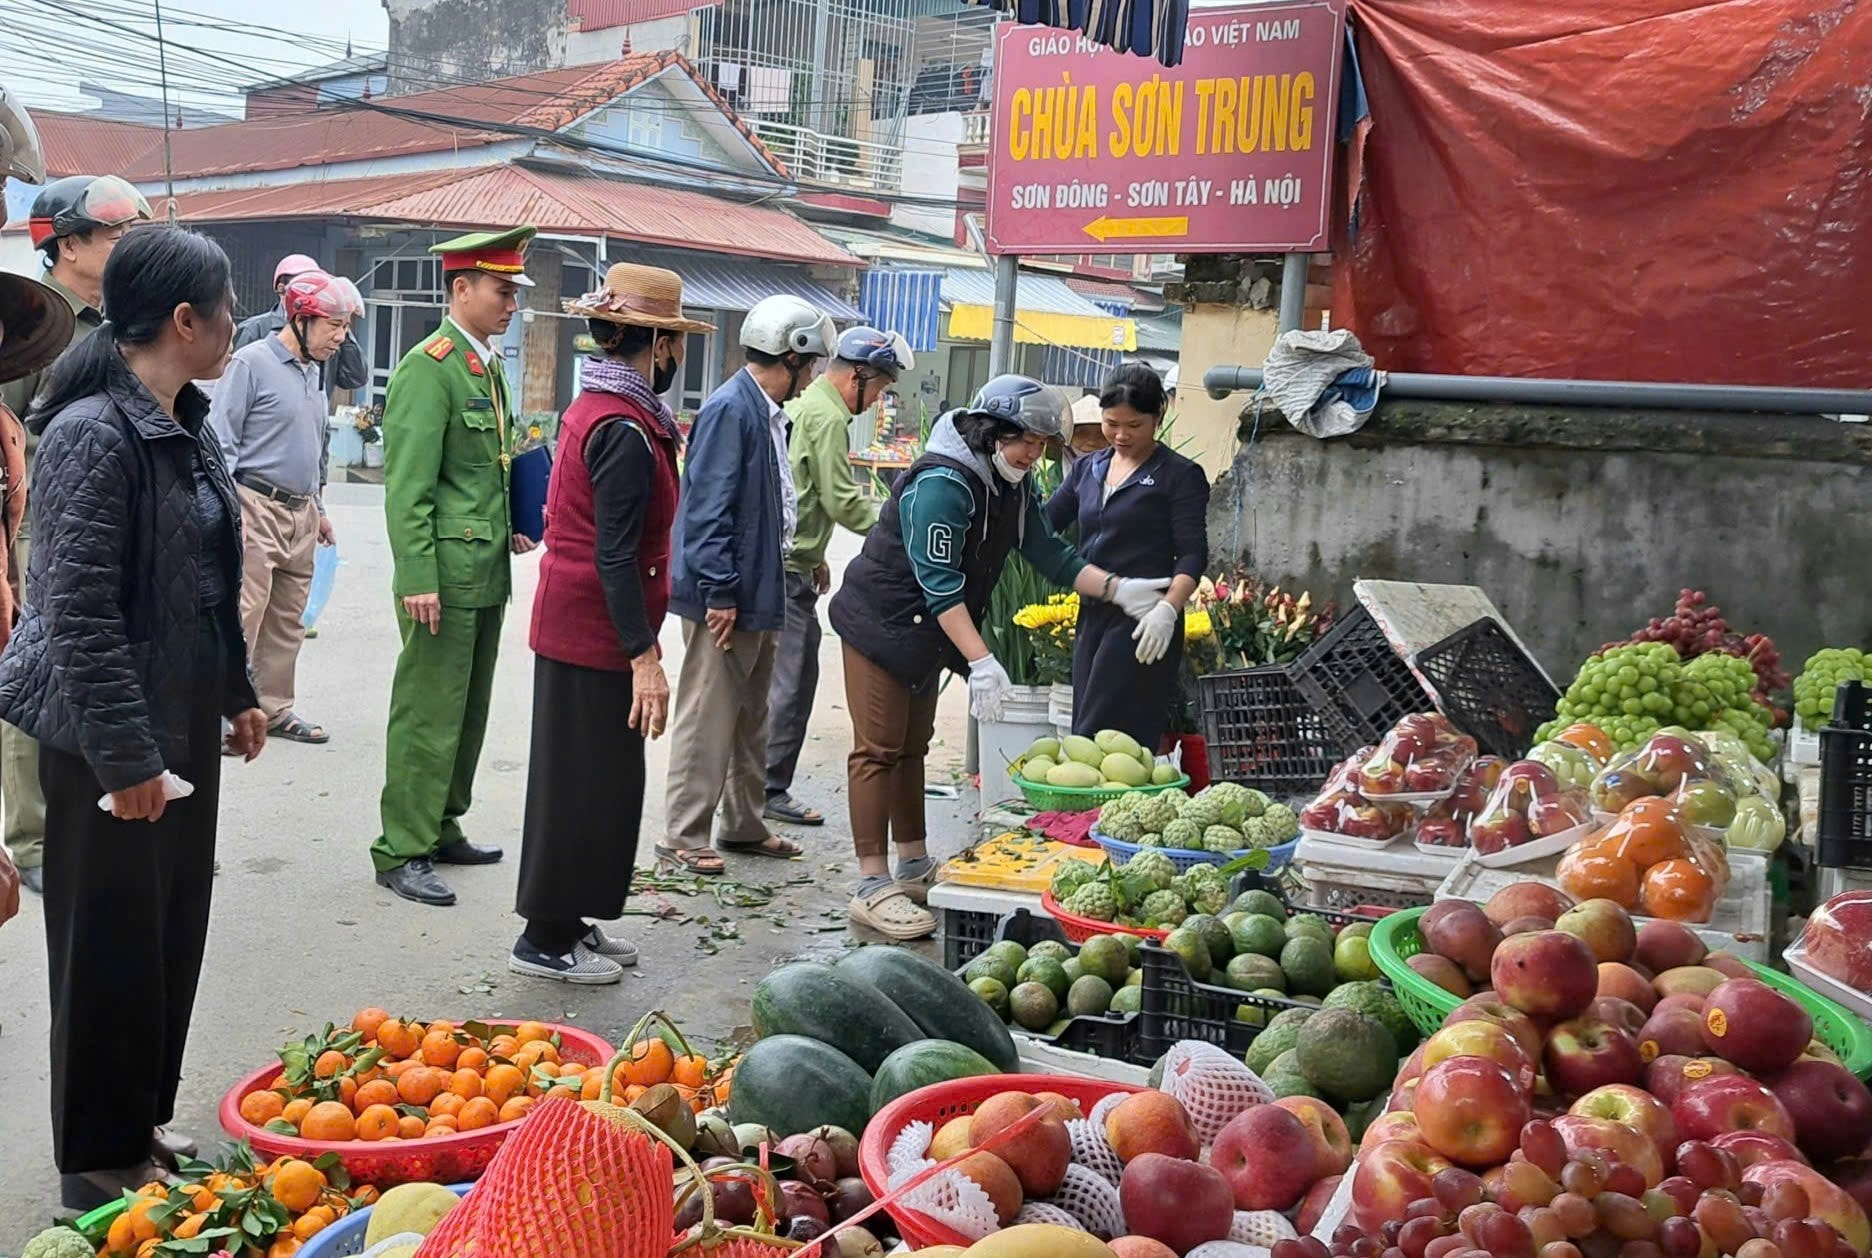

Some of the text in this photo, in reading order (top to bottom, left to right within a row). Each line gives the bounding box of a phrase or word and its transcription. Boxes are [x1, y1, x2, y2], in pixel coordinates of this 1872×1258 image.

[1029, 32, 1071, 56] GIÁO
[1211, 19, 1250, 48] VIỆT
[1255, 19, 1300, 42] NAM
[1009, 71, 1315, 161] CHÙA SƠN TRUNG
[1011, 183, 1050, 209] SƠN
[1055, 178, 1108, 208] ĐÔNG
[1127, 179, 1169, 207] SƠN
[1175, 175, 1212, 206] TÂY
[1229, 174, 1257, 205] HÀ
[1264, 172, 1302, 209] NỘI
[927, 522, 952, 563] G
